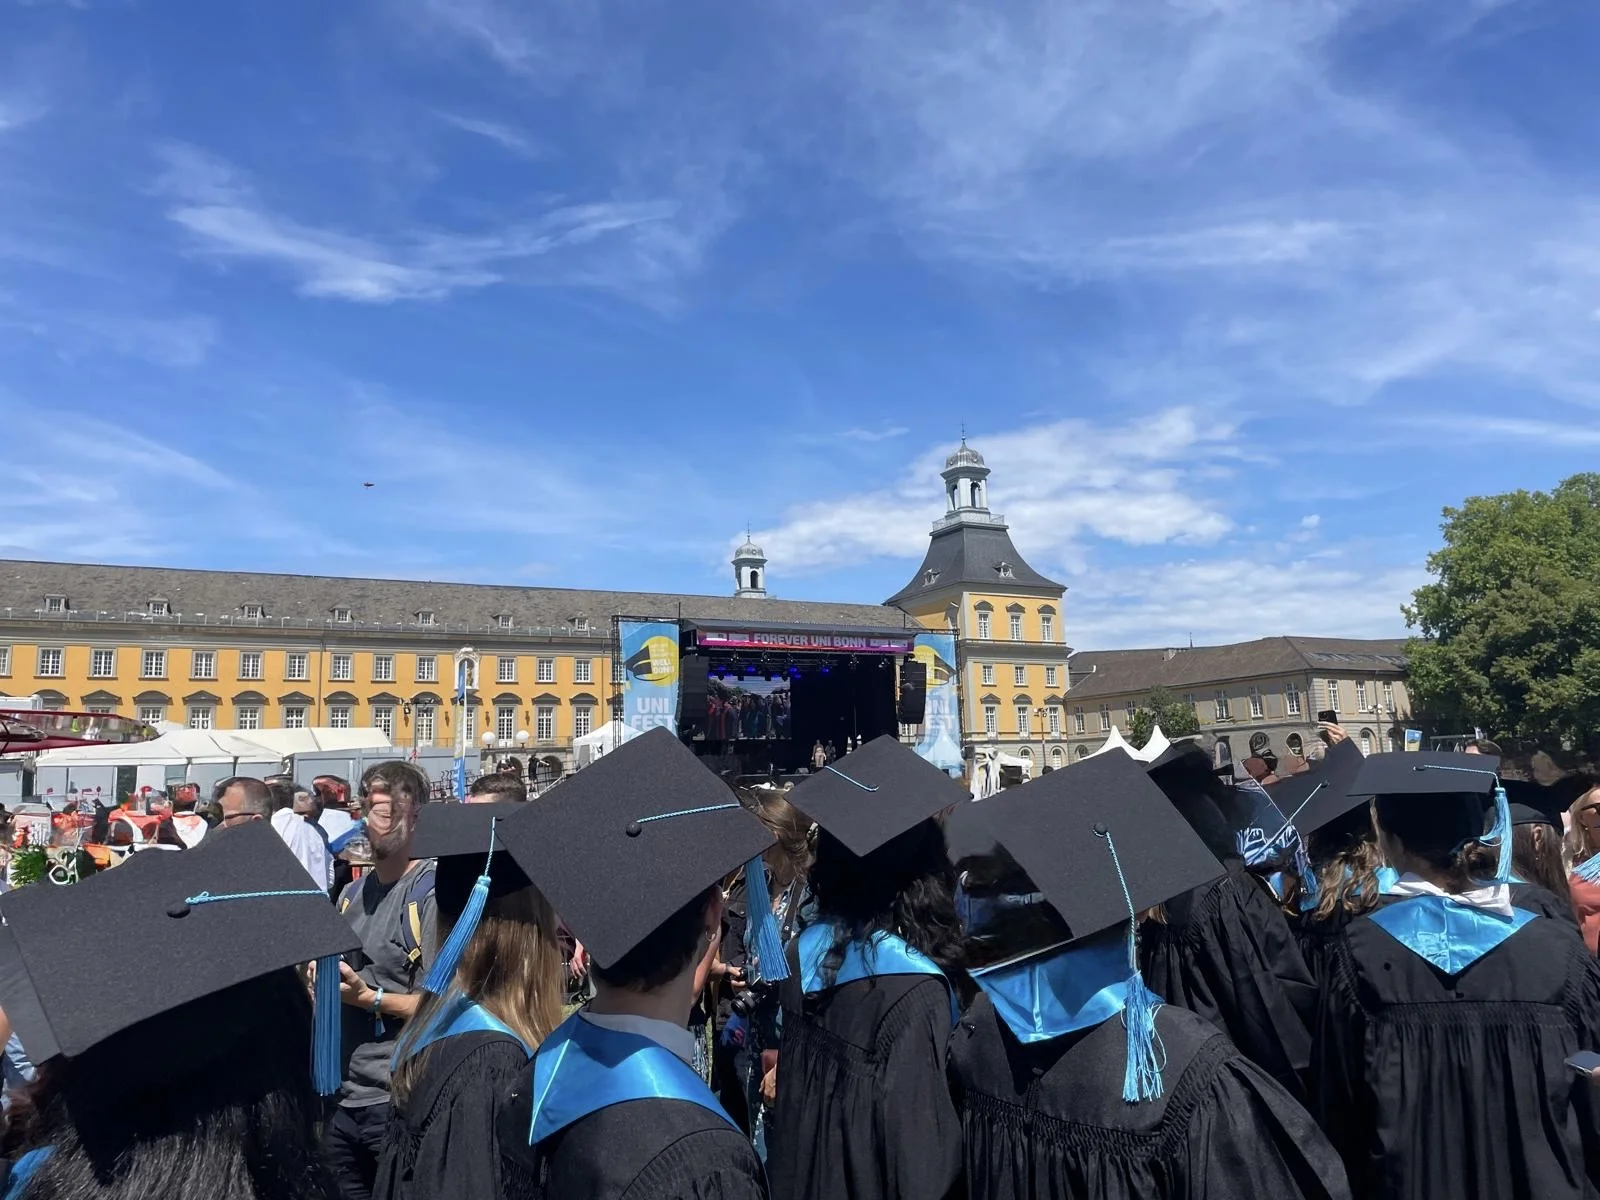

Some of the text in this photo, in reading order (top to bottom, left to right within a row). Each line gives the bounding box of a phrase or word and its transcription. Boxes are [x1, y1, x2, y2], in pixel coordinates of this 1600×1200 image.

[754, 633, 808, 646] FOREVER
[811, 635, 832, 646] UNI
[834, 636, 866, 647] BONN
[637, 697, 669, 714] UNI
[632, 714, 674, 731] FEST
